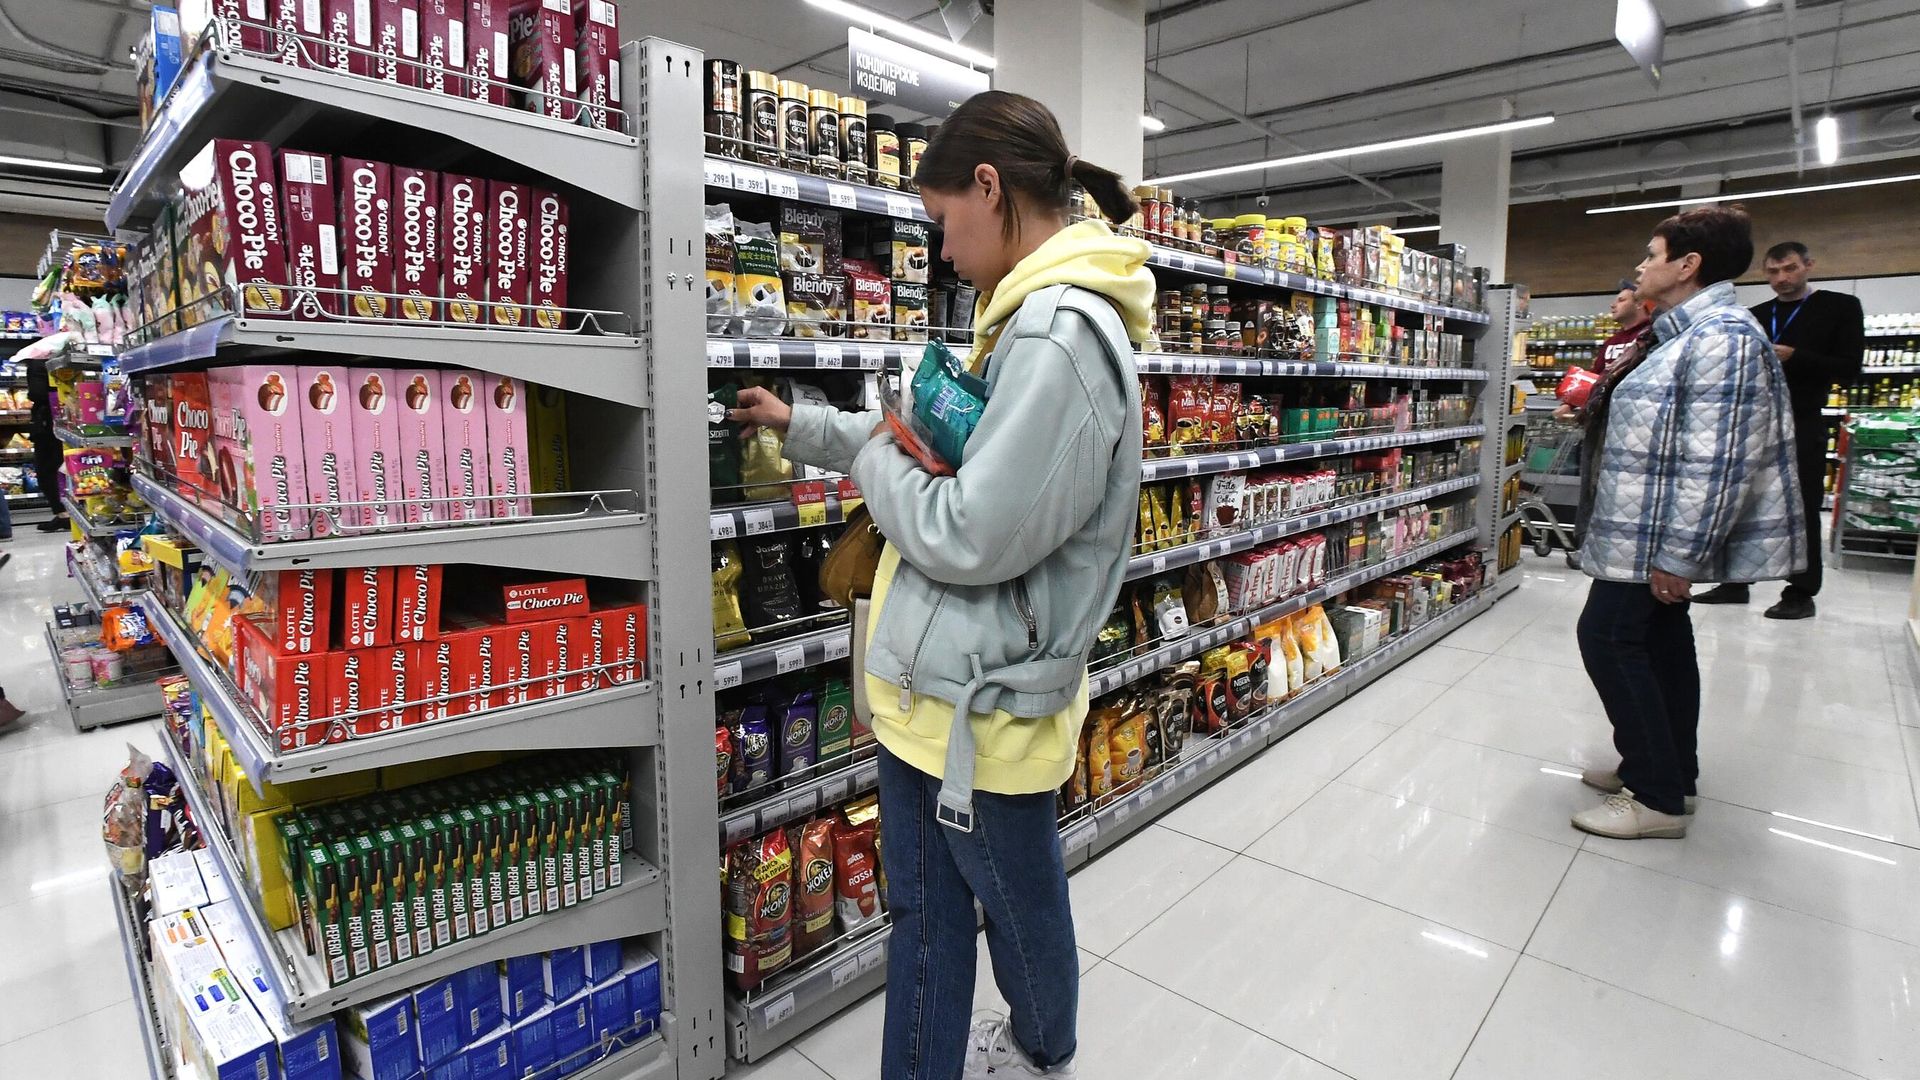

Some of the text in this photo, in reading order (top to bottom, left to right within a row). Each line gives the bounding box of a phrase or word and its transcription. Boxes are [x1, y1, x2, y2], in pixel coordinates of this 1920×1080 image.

[856, 51, 920, 87] КОНДИТЕРСКИЕ
[856, 70, 897, 97] ИЗДЕЛИЯ
[713, 173, 725, 184] 299
[748, 179, 760, 191] 359
[262, 197, 278, 242] ORION
[785, 208, 825, 228] Blendy
[894, 222, 924, 237] Blendy
[377, 214, 389, 255] ORION
[425, 220, 436, 259] ORION
[473, 225, 483, 263] ORION
[517, 231, 527, 269] ORION
[558, 237, 567, 272] ORION
[793, 276, 833, 296] Blendy
[855, 279, 885, 294] Blendy
[897, 286, 924, 299] Blendy
[716, 356, 727, 364] 479
[177, 401, 209, 430] Choco
[178, 431, 199, 459] Pie
[460, 447, 473, 470] Pie
[503, 446, 515, 468] Pie
[271, 454, 286, 479] Pie
[322, 452, 336, 475] Pie
[370, 451, 384, 475] Pie
[416, 449, 430, 472] Pie
[262, 495, 270, 534] LOTE
[408, 486, 416, 518] LOTE
[413, 583, 428, 625] Choco
[519, 586, 549, 597] LOTTE
[522, 592, 584, 611] Choco Pie
[287, 607, 296, 640] LOTTE
[298, 592, 315, 637] Choco
[352, 602, 360, 635] LOTTE
[363, 588, 378, 631] Choco
[402, 597, 411, 629] LOTTE
[626, 613, 636, 633] Pie
[518, 630, 530, 653] Pie
[556, 624, 568, 646] Pie
[591, 618, 602, 640] Pie
[392, 649, 406, 674] Pie
[437, 642, 450, 666] Pie
[479, 636, 492, 659] Pie
[294, 662, 309, 687] Pie
[344, 656, 359, 681] Pie
[786, 721, 812, 745] ЖОКЕЙ
[823, 708, 848, 731] ЖОКЕЙ
[621, 802, 631, 828] PEPERO
[578, 847, 590, 875] PEPERO
[593, 839, 604, 867] PEPERO
[609, 835, 620, 863] PEPERO
[507, 866, 520, 896] PEPERO
[525, 860, 538, 890] PEPERO
[544, 857, 556, 886] PEPERO
[562, 853, 575, 882] PEPERO
[806, 861, 834, 894] ЖОКЕЙ
[452, 882, 465, 913] PEPERO
[471, 878, 485, 908] PEPERO
[489, 871, 503, 902] PEPERO
[413, 896, 427, 928] PEPERO
[431, 888, 446, 919] PEPERO
[760, 887, 791, 918] ЖОКЕЙ
[370, 909, 386, 941] PEPERO
[391, 902, 407, 933] PEPERO
[325, 924, 343, 956] PEPERO
[348, 916, 365, 948] PEPERO
